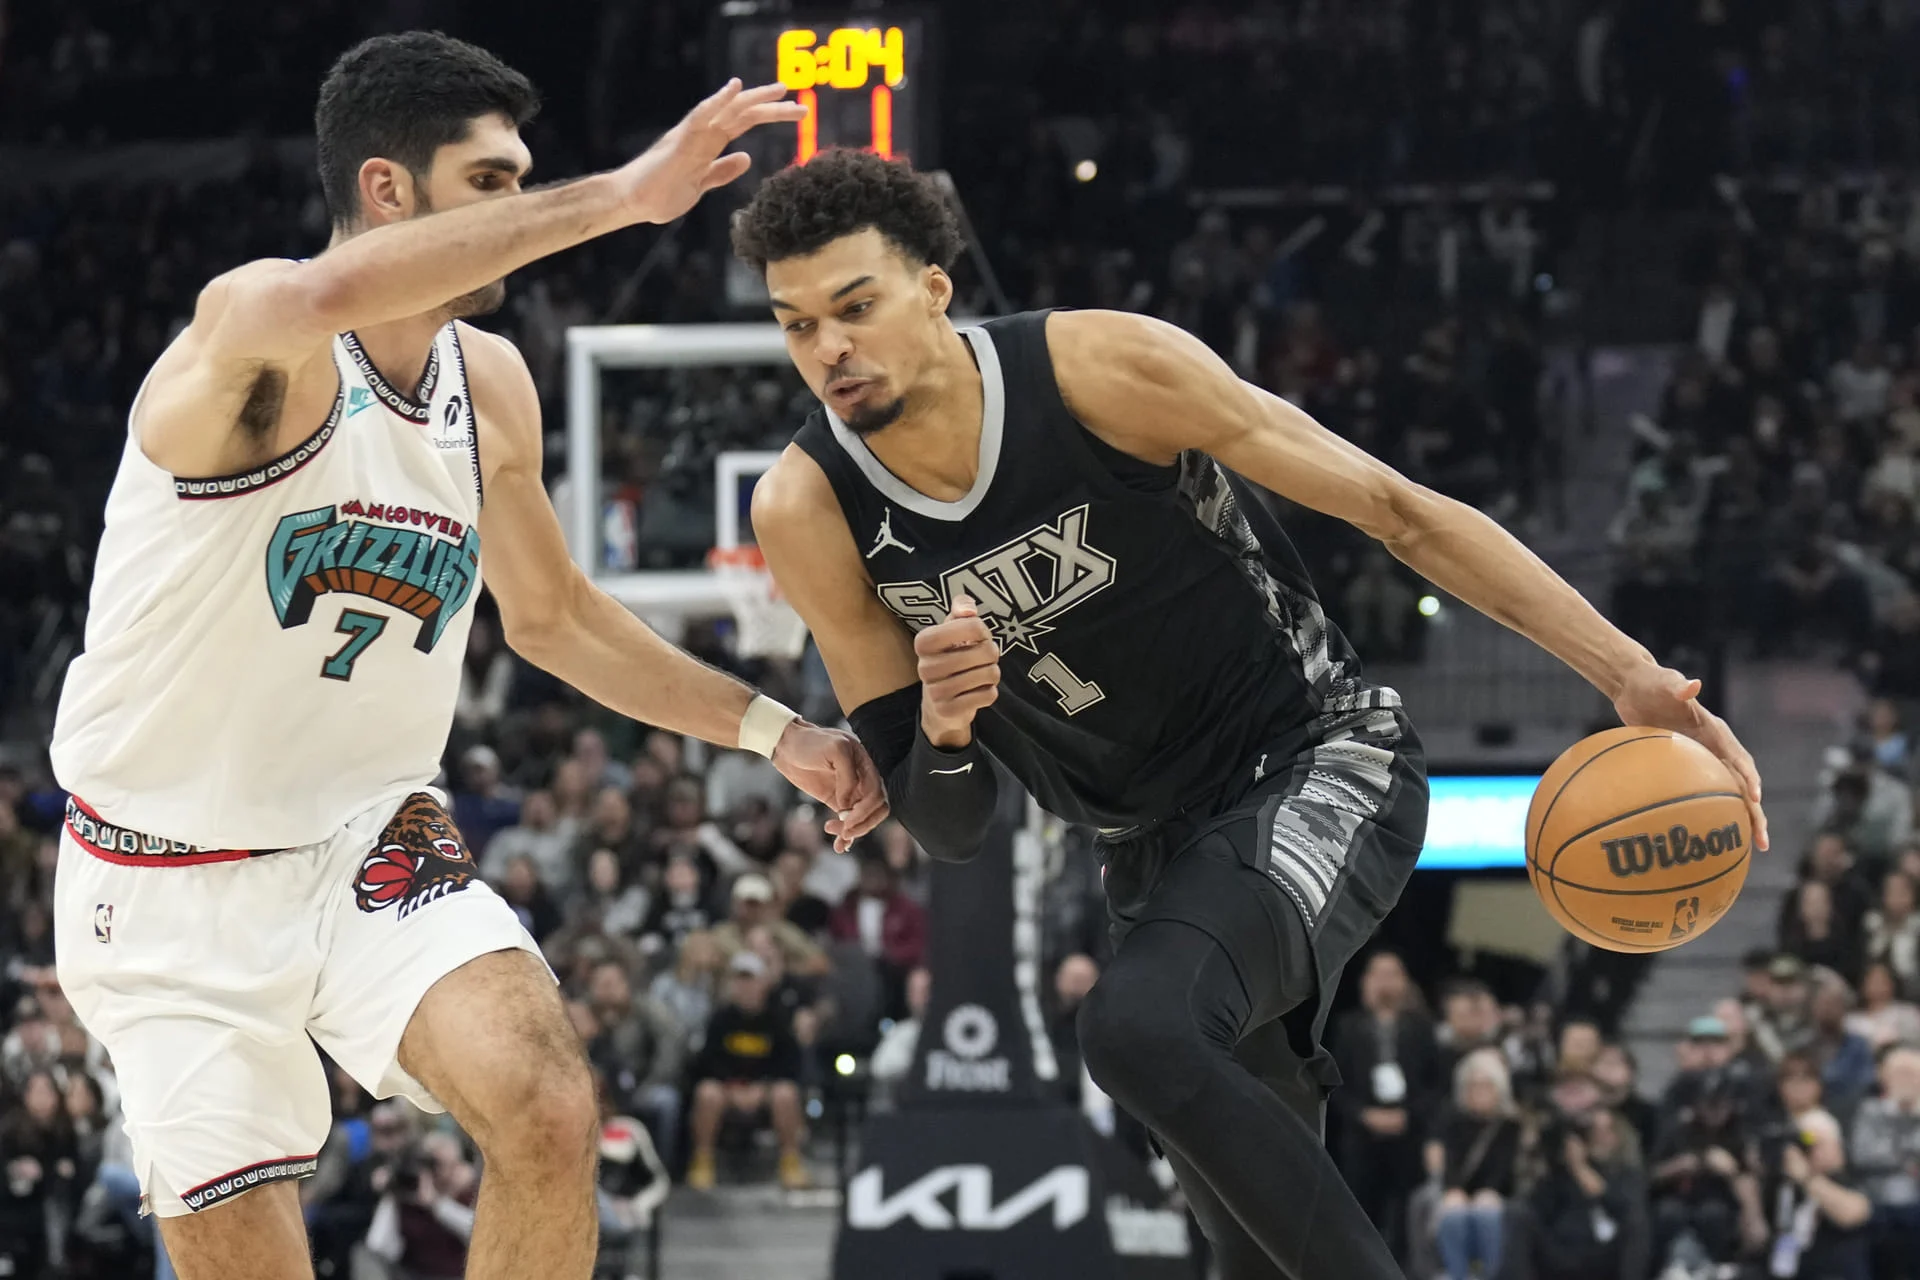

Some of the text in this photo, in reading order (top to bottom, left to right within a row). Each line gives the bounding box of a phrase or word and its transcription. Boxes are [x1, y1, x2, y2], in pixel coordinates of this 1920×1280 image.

[777, 26, 904, 90] 6:04
[341, 499, 463, 540] VANCOUVER
[265, 504, 481, 655] GRIZZLIES
[877, 503, 1117, 642] SATX
[320, 607, 390, 682] 7
[1028, 652, 1106, 716] 1
[1601, 821, 1743, 877] Wilson
[849, 1165, 1090, 1230] KIA
